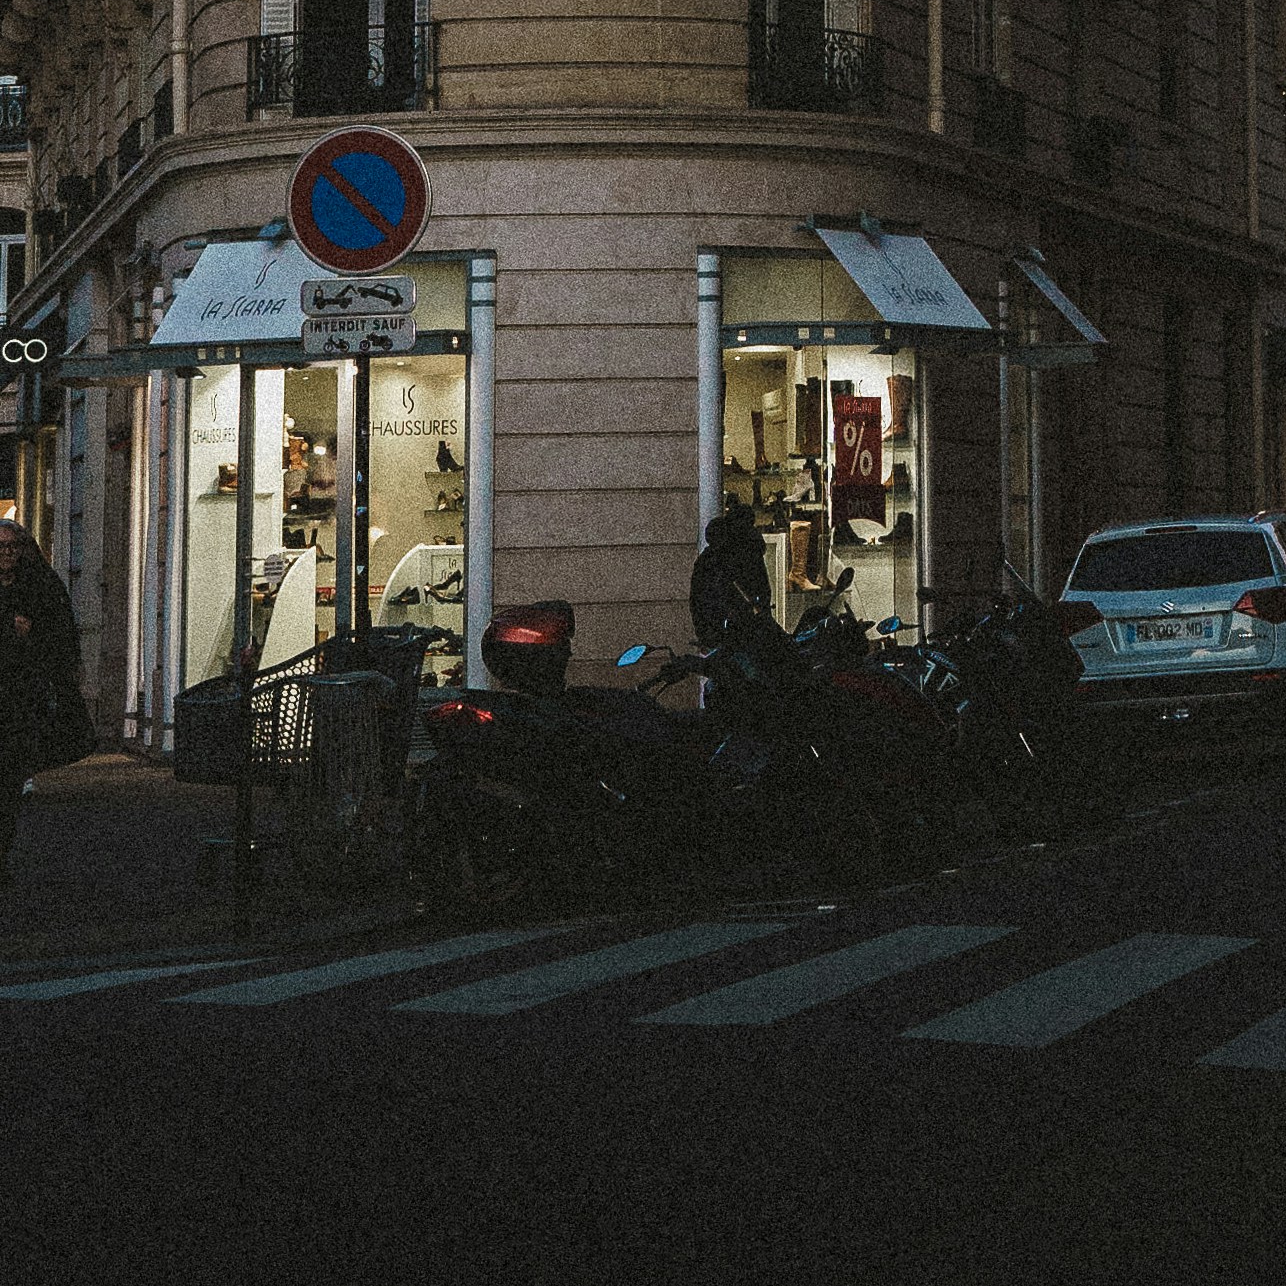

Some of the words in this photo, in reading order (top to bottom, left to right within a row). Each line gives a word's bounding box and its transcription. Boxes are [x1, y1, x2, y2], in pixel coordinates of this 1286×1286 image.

[201, 298, 223, 321] LA
[309, 318, 367, 333] INTERDIT
[372, 318, 406, 331] SAUF
[370, 419, 458, 436] HAUSSURES
